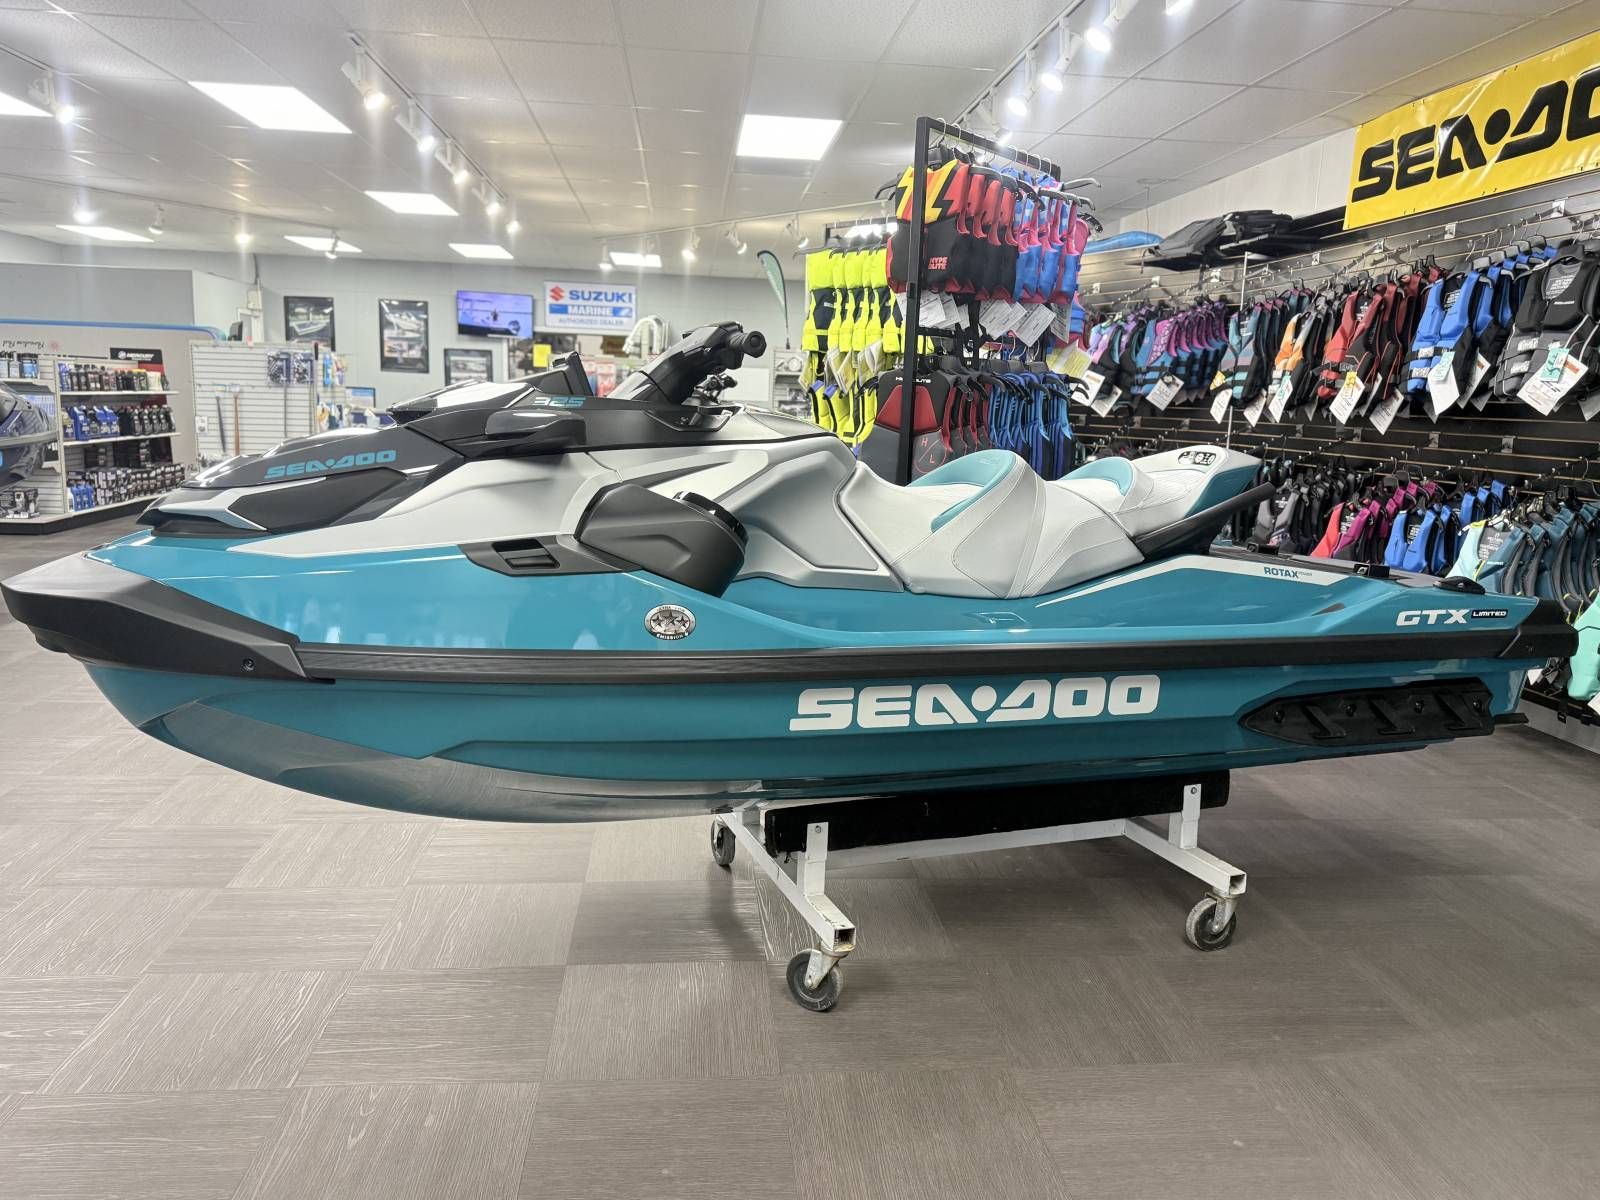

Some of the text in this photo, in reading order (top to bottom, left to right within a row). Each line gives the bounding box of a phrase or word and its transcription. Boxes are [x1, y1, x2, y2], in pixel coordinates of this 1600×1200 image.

[568, 289, 632, 303] SUZUKI
[569, 303, 613, 317] MARINE
[599, 319, 624, 327] DEALER
[533, 396, 587, 407] 325
[1263, 566, 1299, 579] ROTAX
[1396, 609, 1470, 626] GTX
